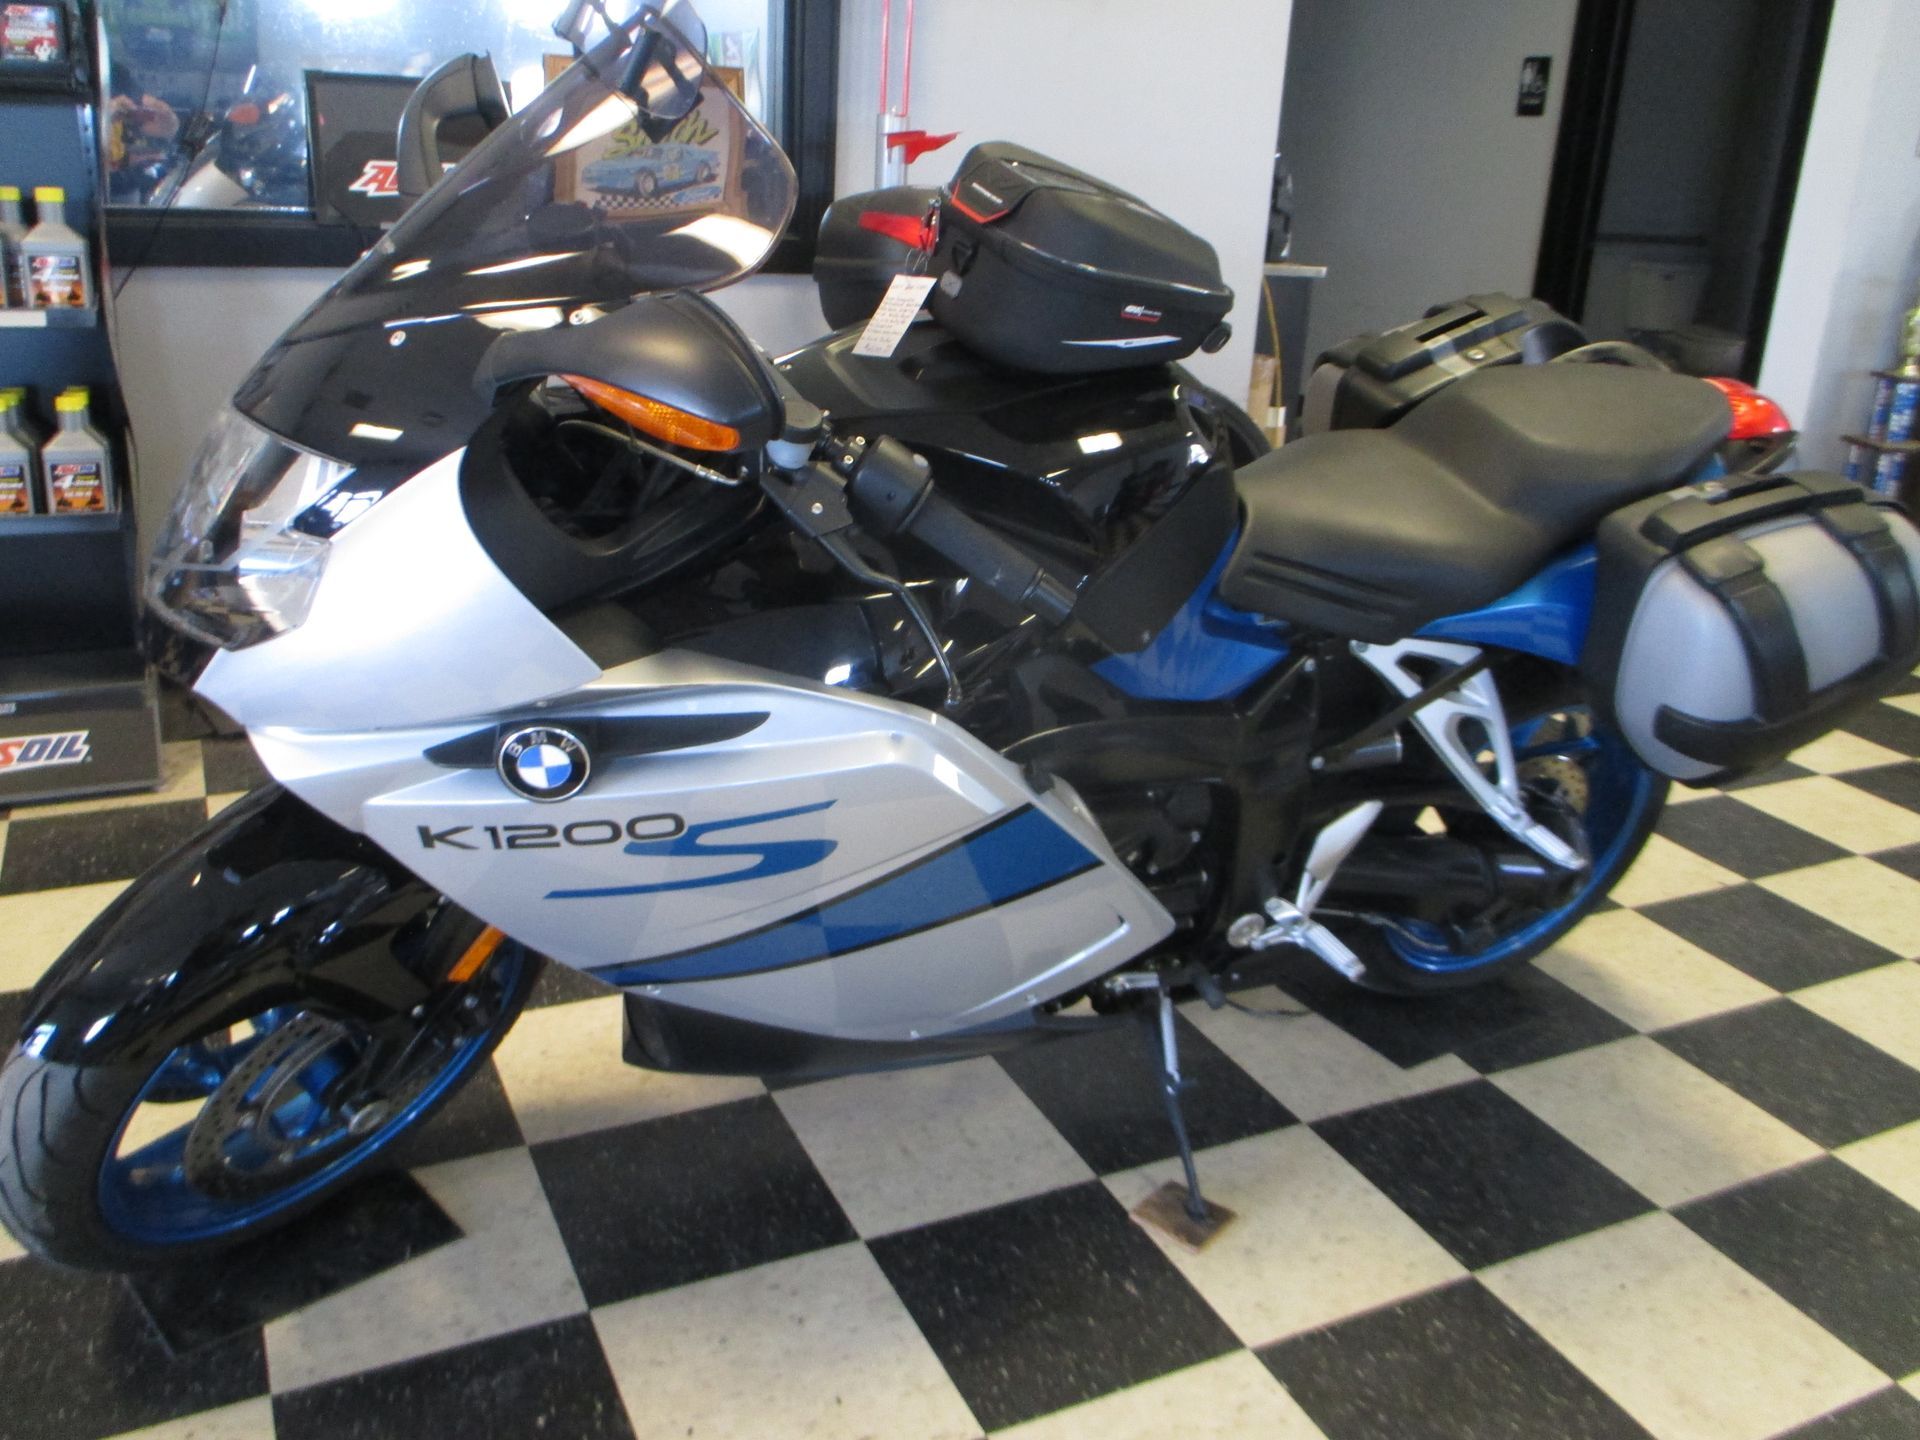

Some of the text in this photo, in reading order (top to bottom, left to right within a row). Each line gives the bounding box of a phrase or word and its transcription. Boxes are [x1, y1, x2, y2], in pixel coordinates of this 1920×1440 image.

[507, 731, 577, 758] BMW
[416, 799, 839, 900] K1200 S
